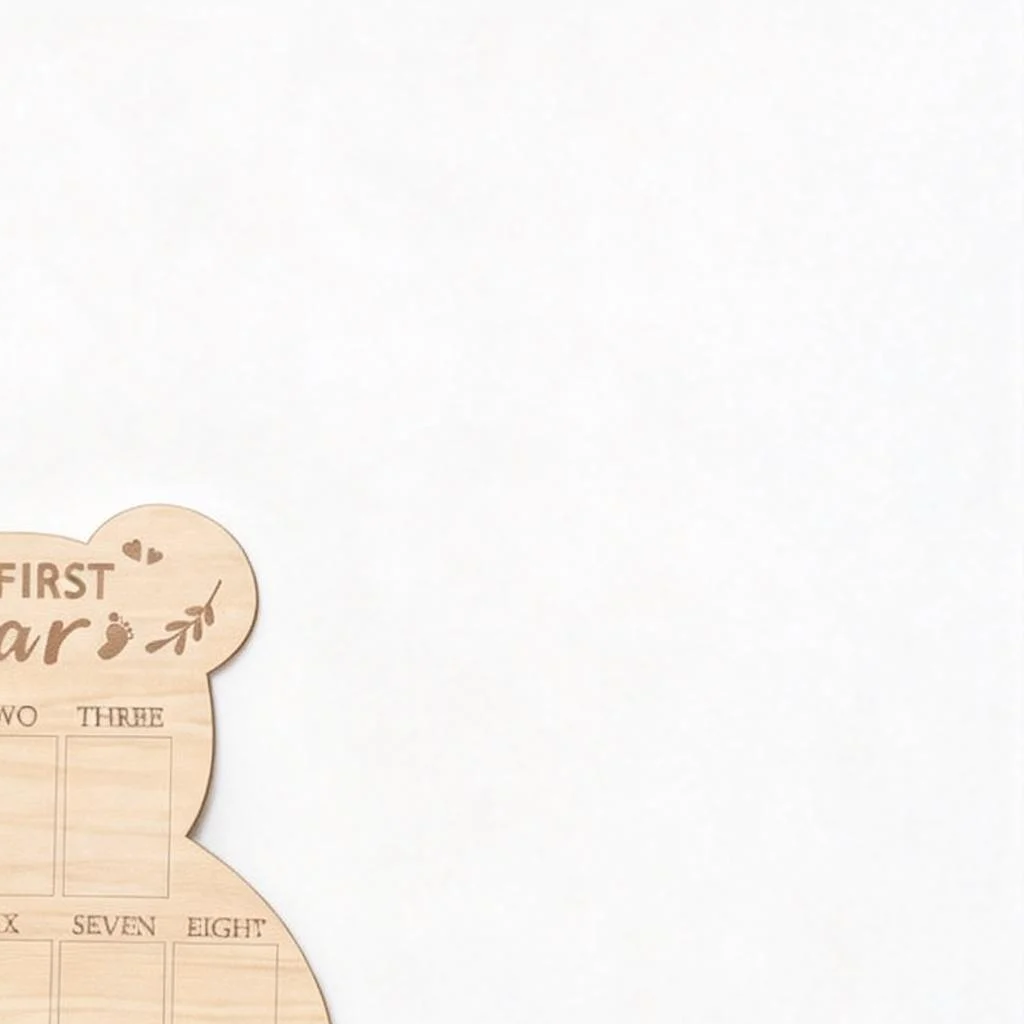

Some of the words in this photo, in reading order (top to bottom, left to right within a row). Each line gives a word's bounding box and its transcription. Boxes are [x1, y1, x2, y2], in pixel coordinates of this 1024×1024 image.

[77, 706, 164, 728] THREE
[73, 914, 156, 937] SEVEN
[187, 916, 267, 939] EIGHT
